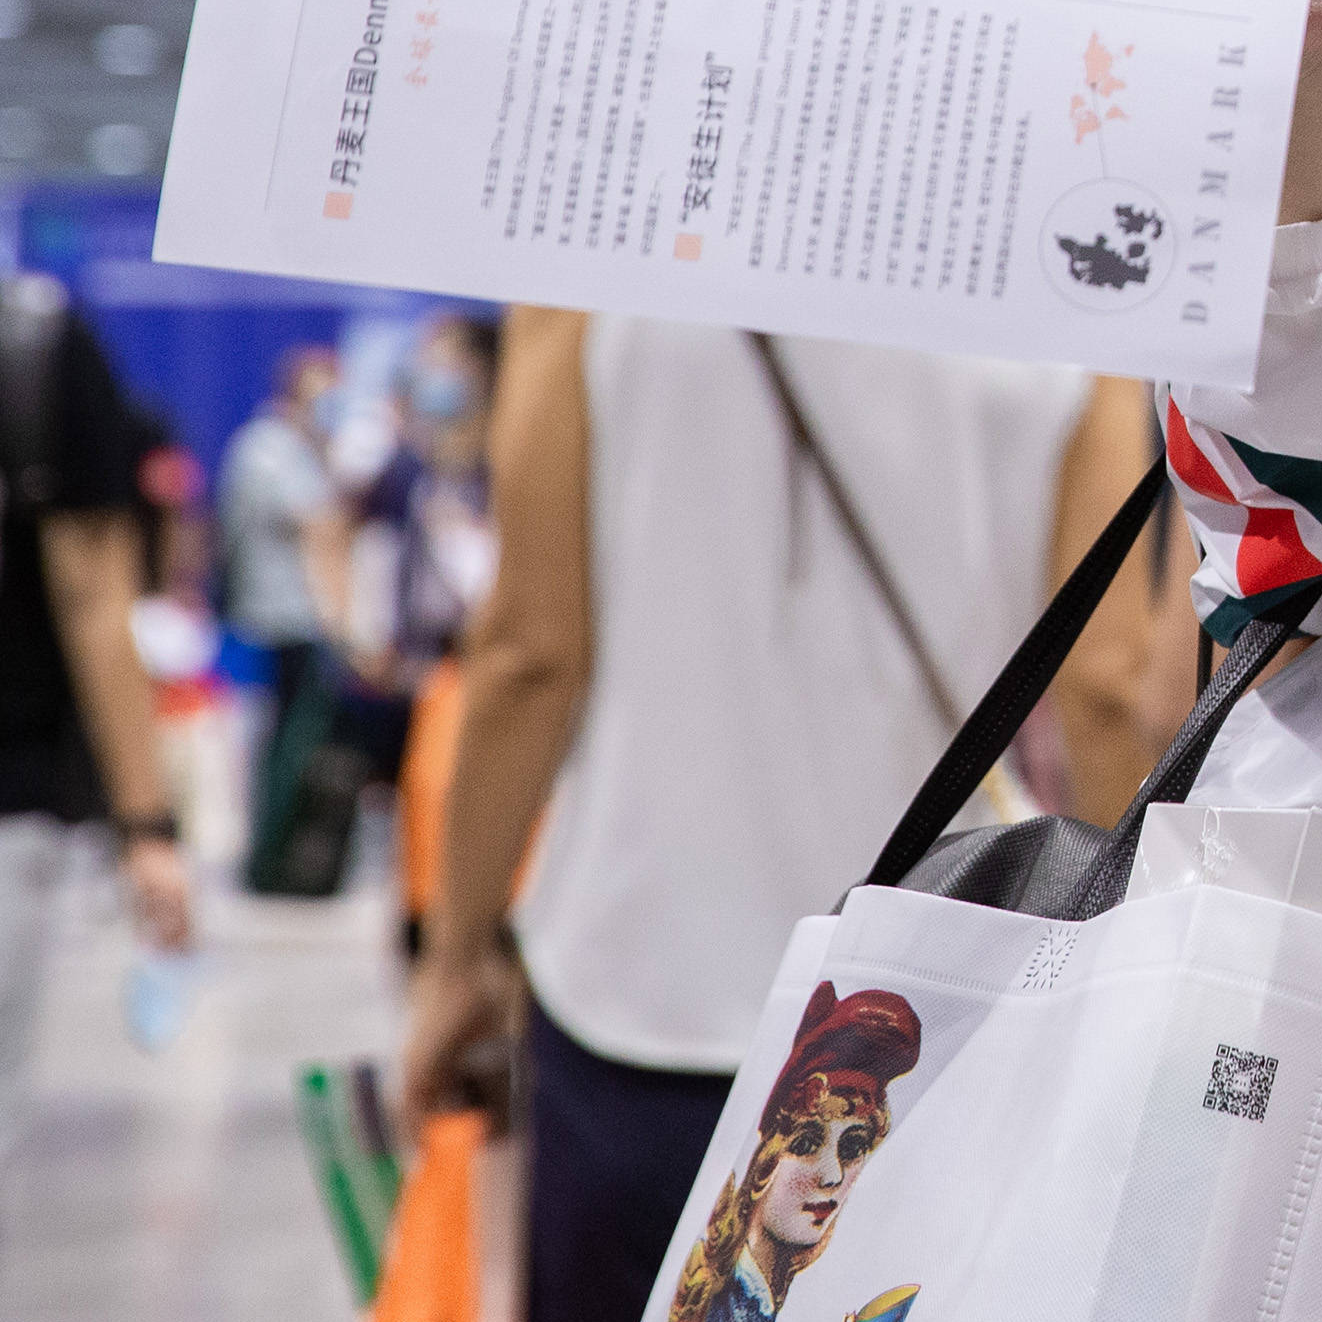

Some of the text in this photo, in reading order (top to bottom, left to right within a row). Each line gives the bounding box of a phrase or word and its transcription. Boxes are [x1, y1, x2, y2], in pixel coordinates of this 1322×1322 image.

[677, 49, 735, 226] “安徒生计划”
[1182, 44, 1246, 323] DANMARK
